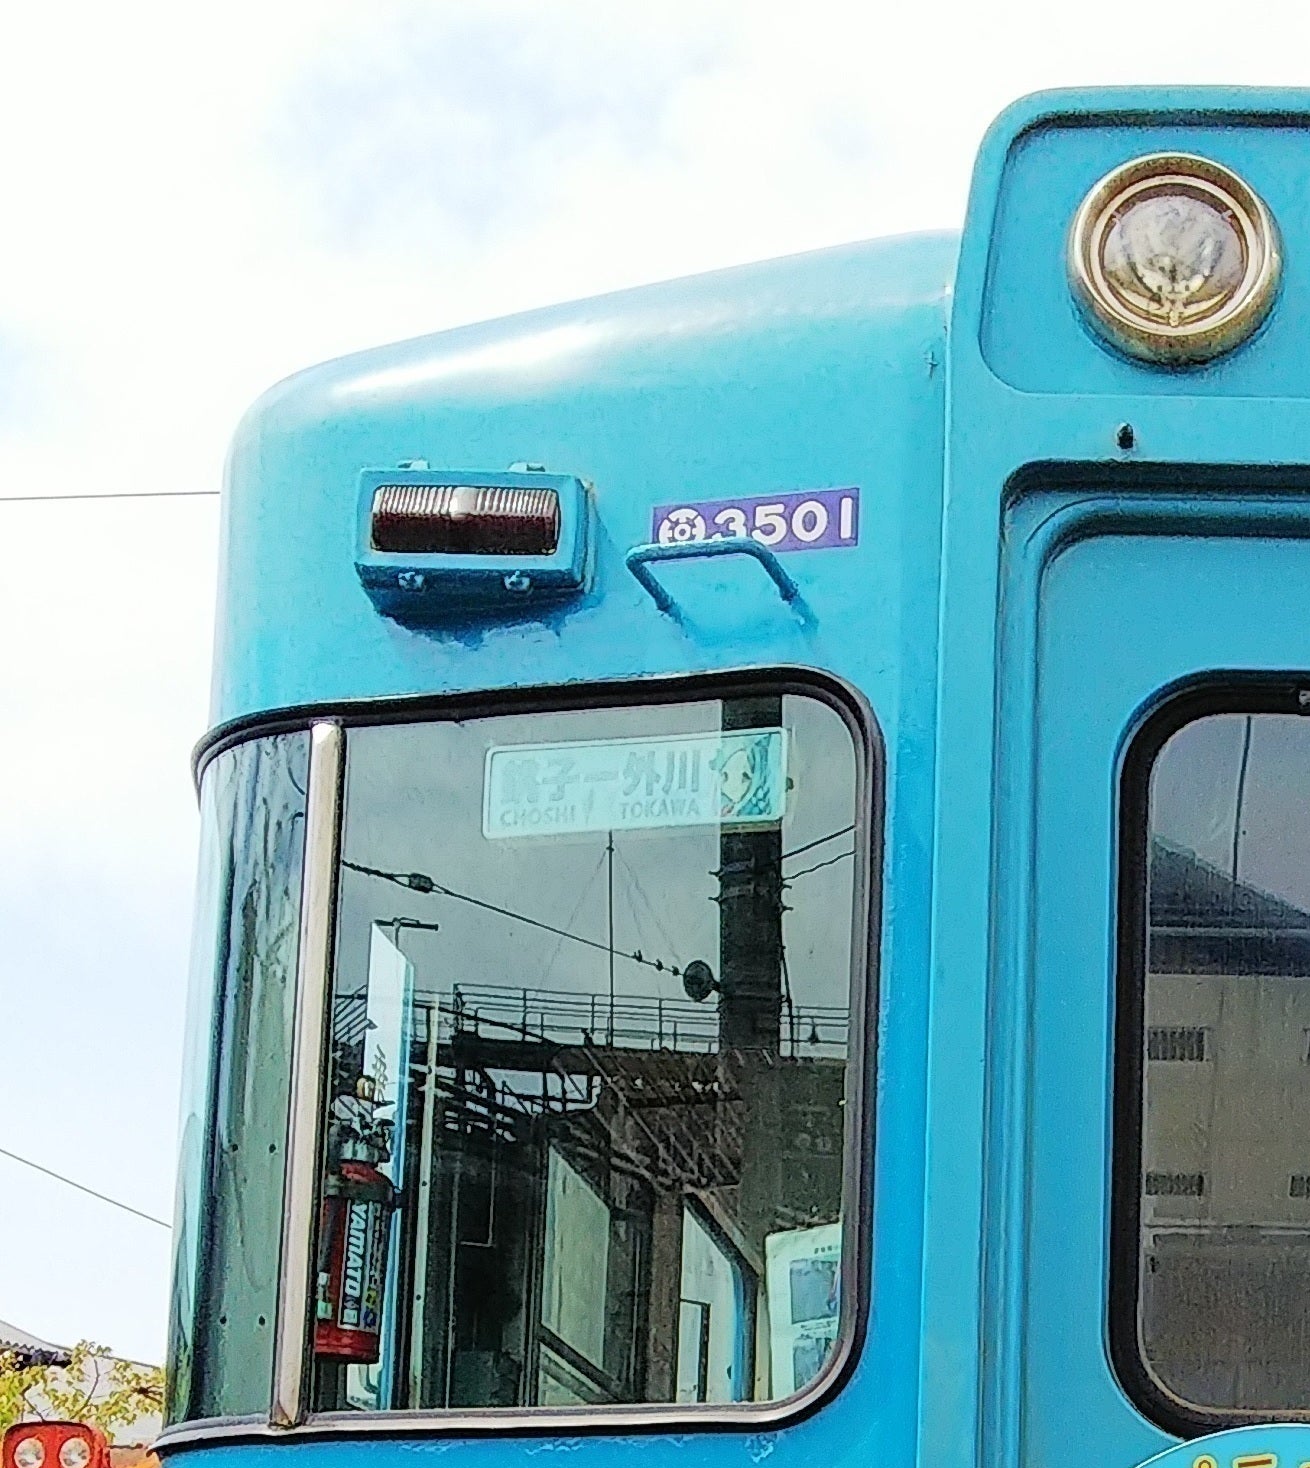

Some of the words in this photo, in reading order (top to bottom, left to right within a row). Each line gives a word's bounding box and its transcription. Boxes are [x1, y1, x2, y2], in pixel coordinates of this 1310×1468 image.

[711, 497, 854, 546] 3501
[619, 798, 701, 820] TOKAWA
[344, 1202, 368, 1299] YAMATO
